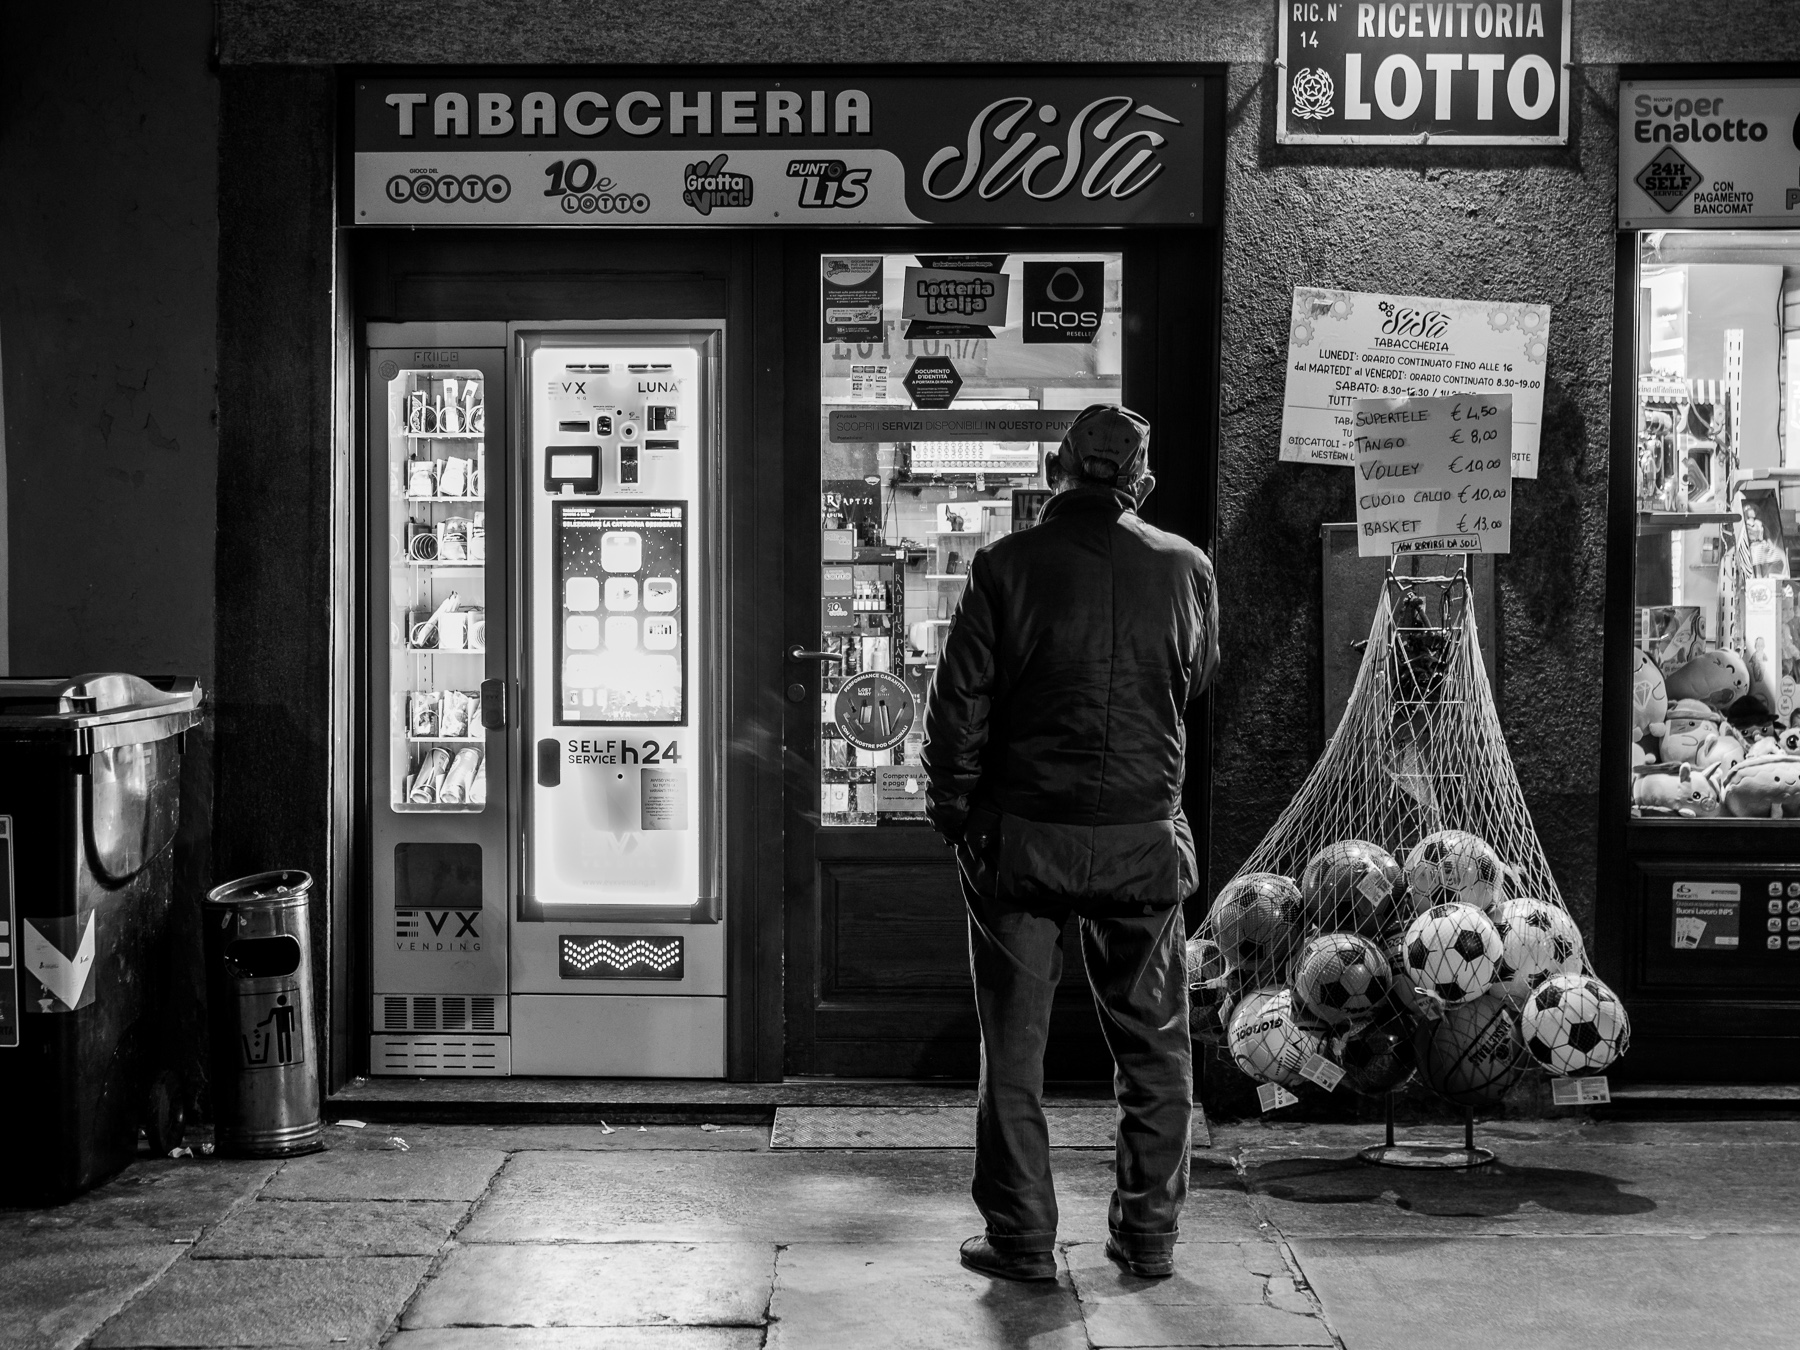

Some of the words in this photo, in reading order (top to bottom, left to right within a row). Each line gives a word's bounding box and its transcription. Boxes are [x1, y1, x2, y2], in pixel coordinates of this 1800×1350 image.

[1357, 3, 1545, 39] RICEVITORIA
[1300, 30, 1319, 49] 14
[1344, 53, 1556, 121] LOTTO
[385, 90, 871, 136] TABACCHERIA
[1634, 94, 1724, 122] Super
[1634, 118, 1768, 143] Enalotto
[789, 161, 844, 179] PUNTO
[1651, 163, 1686, 176] 24H
[386, 174, 511, 204] LOTTO
[686, 174, 744, 191] Gratta
[1645, 176, 1692, 191] SELF
[1713, 181, 1734, 192] CON
[561, 193, 650, 214] LOTTO
[1694, 192, 1754, 203] PAGAMENTO
[1694, 204, 1754, 214] BANCOMAT
[918, 279, 994, 296] Lotteria
[928, 295, 986, 314] Italia
[1031, 311, 1097, 329] IQOS
[1374, 337, 1449, 352] TABACCHERIA
[1361, 354, 1395, 364] ORARIO
[1397, 356, 1453, 369] CONTINUATO
[1455, 360, 1476, 370] FINO
[1478, 362, 1500, 371] ALLE
[1503, 363, 1513, 372] 16
[1294, 361, 1307, 371] dal
[1354, 368, 1363, 376] al
[1409, 373, 1441, 383] ORARIO
[1443, 375, 1494, 387] CONTINUATO
[1496, 378, 1541, 389] 8.30-19.00
[638, 382, 680, 394] LUNA
[1335, 381, 1379, 393] SABATO:
[1355, 410, 1429, 427] SUPERTELE
[1450, 403, 1462, 421] €
[1466, 406, 1498, 421] 4,50
[836, 421, 875, 431] SCOPRI
[881, 421, 923, 431] SERVIZI
[925, 421, 983, 431] DISPONIBILI
[985, 421, 996, 430] IN
[998, 421, 1043, 431] QUESTO
[1045, 421, 1075, 431] PUNT
[1288, 436, 1340, 448] GIOCATTOLI
[1354, 436, 1405, 454] TANGO
[1449, 429, 1464, 444] €
[1470, 429, 1498, 444] 8,00
[1311, 450, 1348, 460] WESTERN
[1360, 460, 1420, 481] VOLLEY
[1465, 458, 1501, 473] 10,00
[1359, 494, 1406, 510] CUOIO
[1413, 491, 1451, 503] CALCIO
[1471, 488, 1507, 501] 10,00
[1363, 519, 1422, 537] BASKET
[1473, 516, 1503, 532] 13,00
[843, 673, 880, 693] PERFORMANCE
[841, 724, 849, 736] CON
[848, 733, 856, 741] LE
[855, 738, 876, 748] NOSTRE
[887, 725, 909, 745] ORIGINALI
[568, 740, 616, 753] SELF
[621, 740, 682, 764] h24
[568, 755, 616, 764] SERVICE
[882, 772, 909, 780] Compra
[1695, 907, 1718, 915] Lavoro
[396, 943, 481, 951] VENDING
